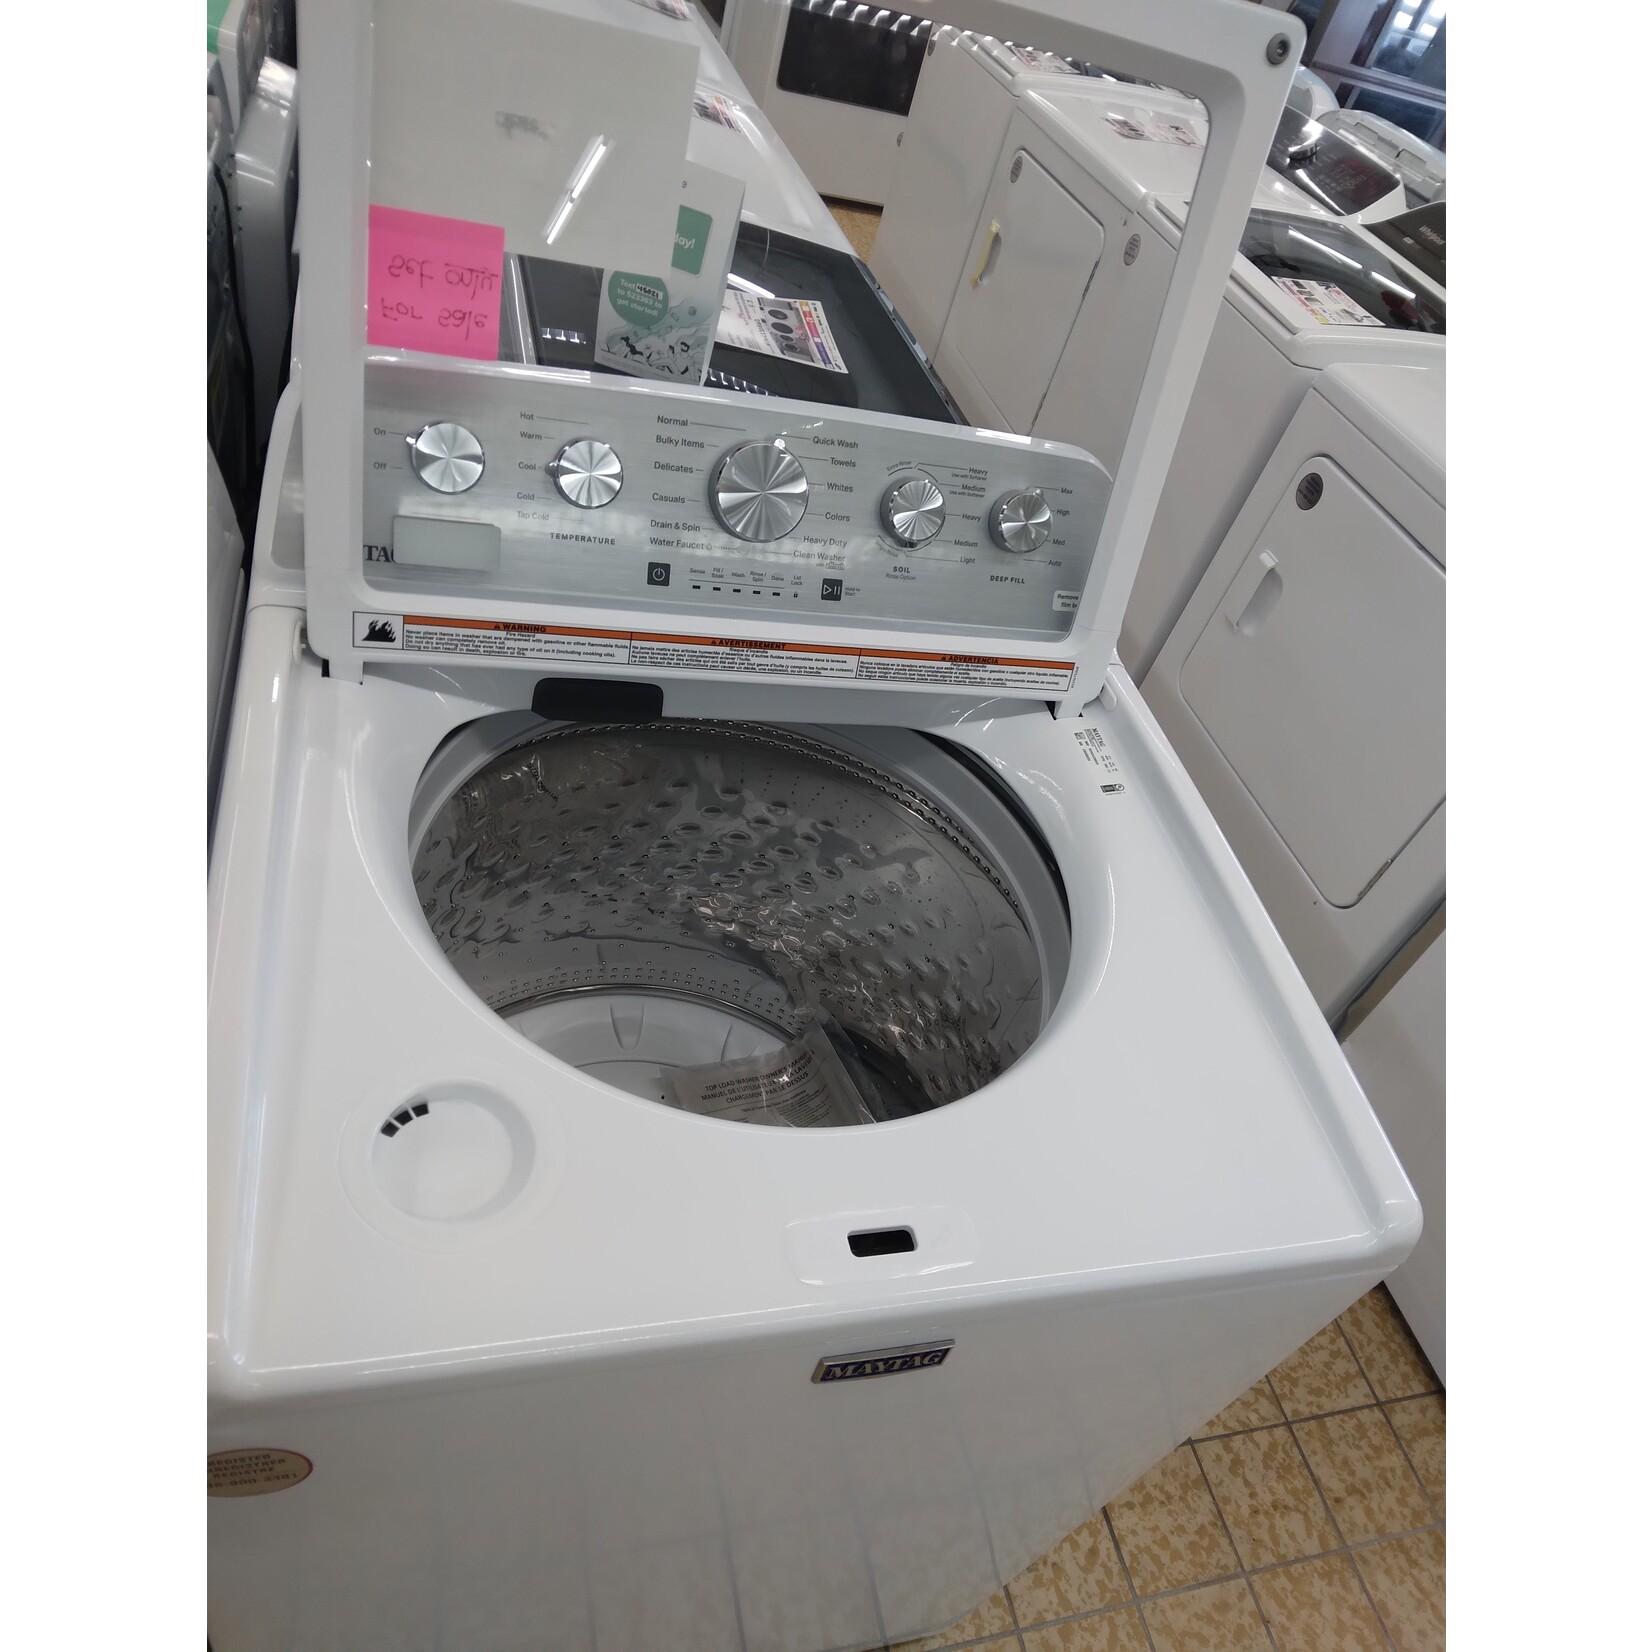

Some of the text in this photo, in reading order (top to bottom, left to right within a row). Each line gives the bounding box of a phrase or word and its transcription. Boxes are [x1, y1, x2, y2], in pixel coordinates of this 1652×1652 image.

[620, 279, 635, 290] Text
[630, 302, 658, 316] started!
[520, 412, 534, 420] Hot
[657, 416, 688, 426] Normal
[374, 427, 386, 436] On
[520, 431, 542, 440] Warm
[656, 435, 704, 448] Bulky Items
[812, 436, 858, 449] Quick Wash
[374, 462, 386, 470] Off
[518, 462, 536, 470] Cool
[654, 461, 694, 474] Delicates
[830, 457, 856, 468] Towels
[886, 463, 898, 471] Extra
[968, 467, 988, 476] Heavy
[826, 482, 854, 492] Whites
[961, 484, 986, 492] Medium
[516, 492, 534, 500] Cold
[652, 492, 686, 504] Casuals
[516, 511, 550, 520] Tap Cold
[824, 512, 850, 522] Colors
[962, 513, 981, 522] Heavy
[650, 520, 700, 532] Drain & Spin
[550, 532, 616, 545] TEMPERATURE
[650, 537, 704, 550] Water Faucet
[804, 536, 848, 548] Heavy Duty
[954, 540, 978, 548] Medium
[794, 550, 846, 562] Clean Washer
[892, 566, 911, 574] SOIL
[502, 624, 546, 632] WARNING
[718, 639, 786, 649] AVERTISSEMENT
[948, 655, 998, 664] ADVERTENCIA
[736, 1077, 758, 1085] WASHER
[726, 1091, 763, 1103] CHARGEMENT
[786, 1072, 808, 1088] DESSUS
[701, 1092, 727, 1100] MANUEL
[825, 1352, 942, 1379] MAYTAG
